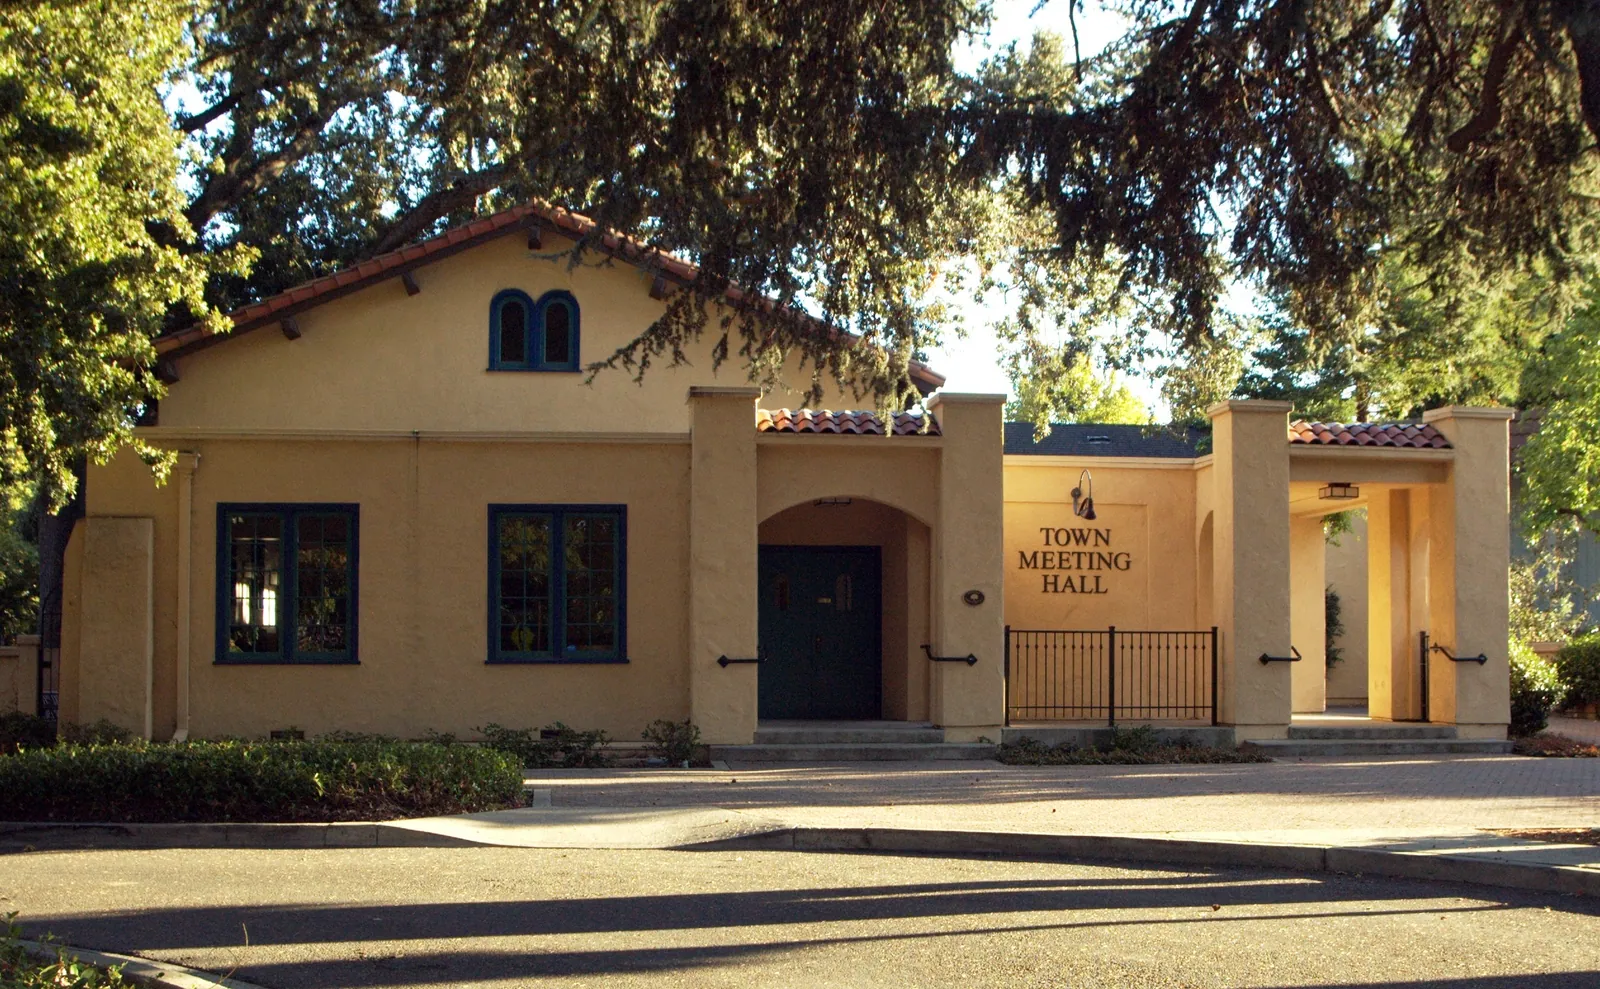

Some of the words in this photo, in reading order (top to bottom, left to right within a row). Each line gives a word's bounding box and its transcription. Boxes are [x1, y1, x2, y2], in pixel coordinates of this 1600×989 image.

[1040, 527, 1111, 547] TOWN
[1018, 550, 1132, 571] MEETING
[1041, 574, 1108, 594] HALL
